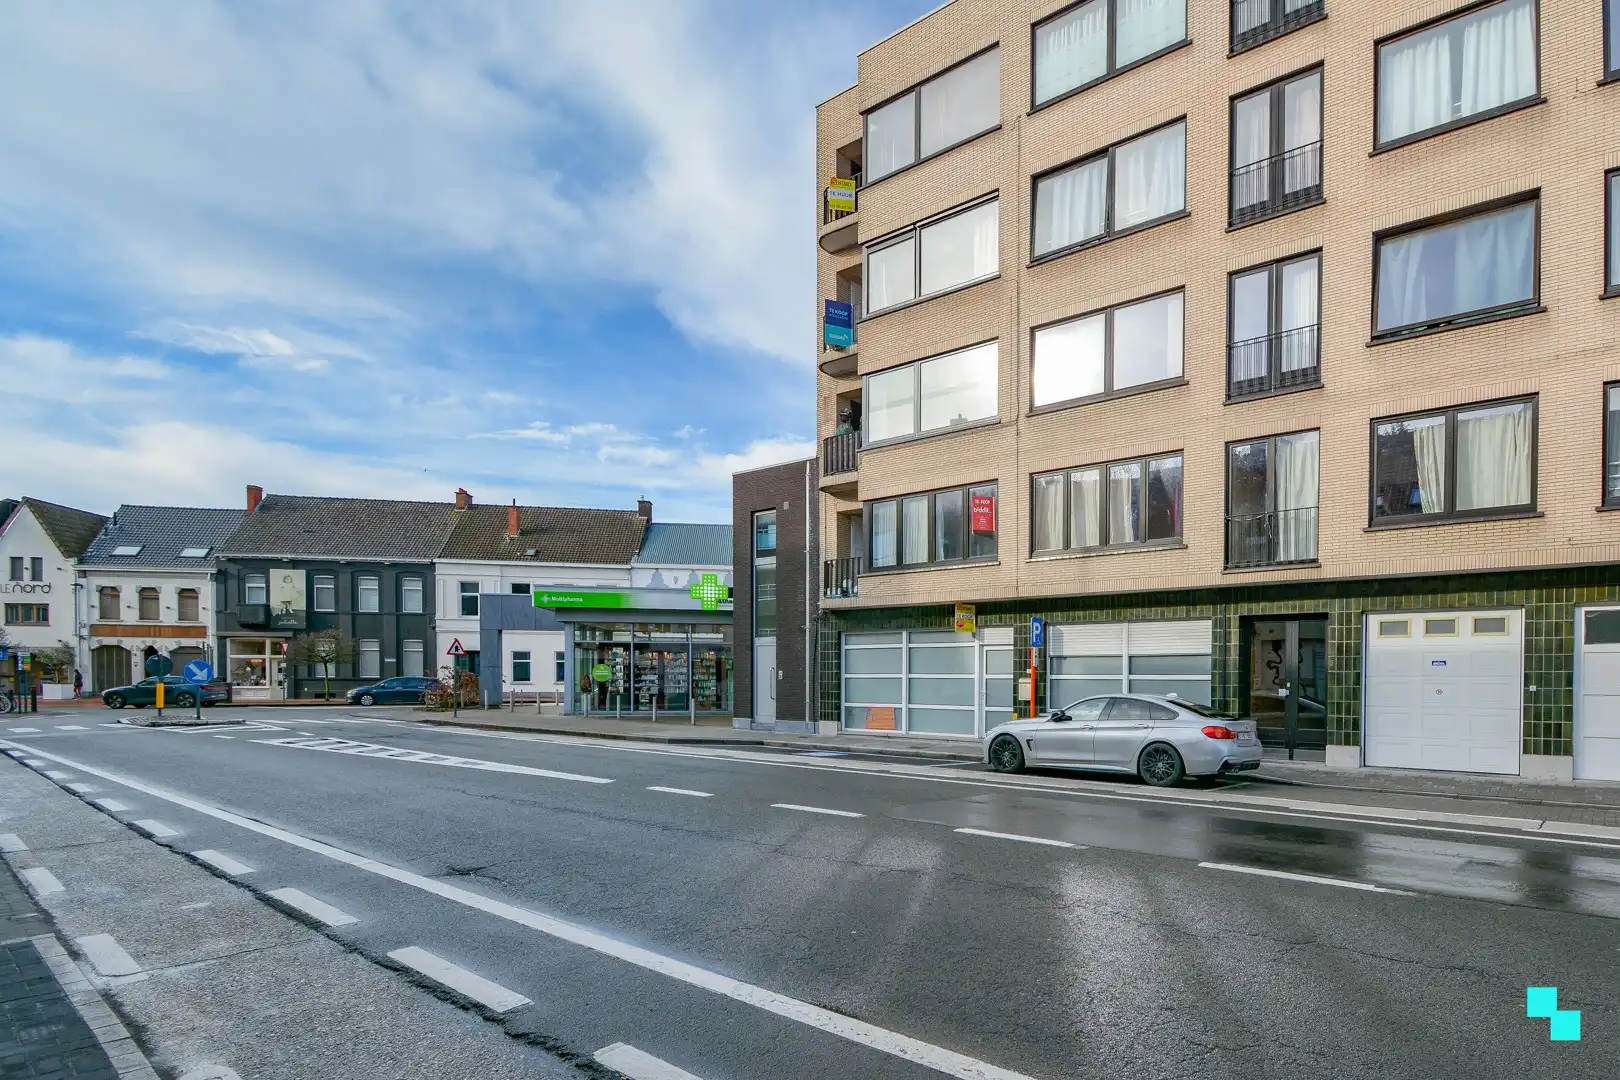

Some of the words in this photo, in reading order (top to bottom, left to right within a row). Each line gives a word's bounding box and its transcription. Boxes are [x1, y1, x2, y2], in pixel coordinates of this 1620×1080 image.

[0, 583, 11, 594] LE
[551, 595, 584, 603] Multipharma
[1033, 622, 1042, 642] P
